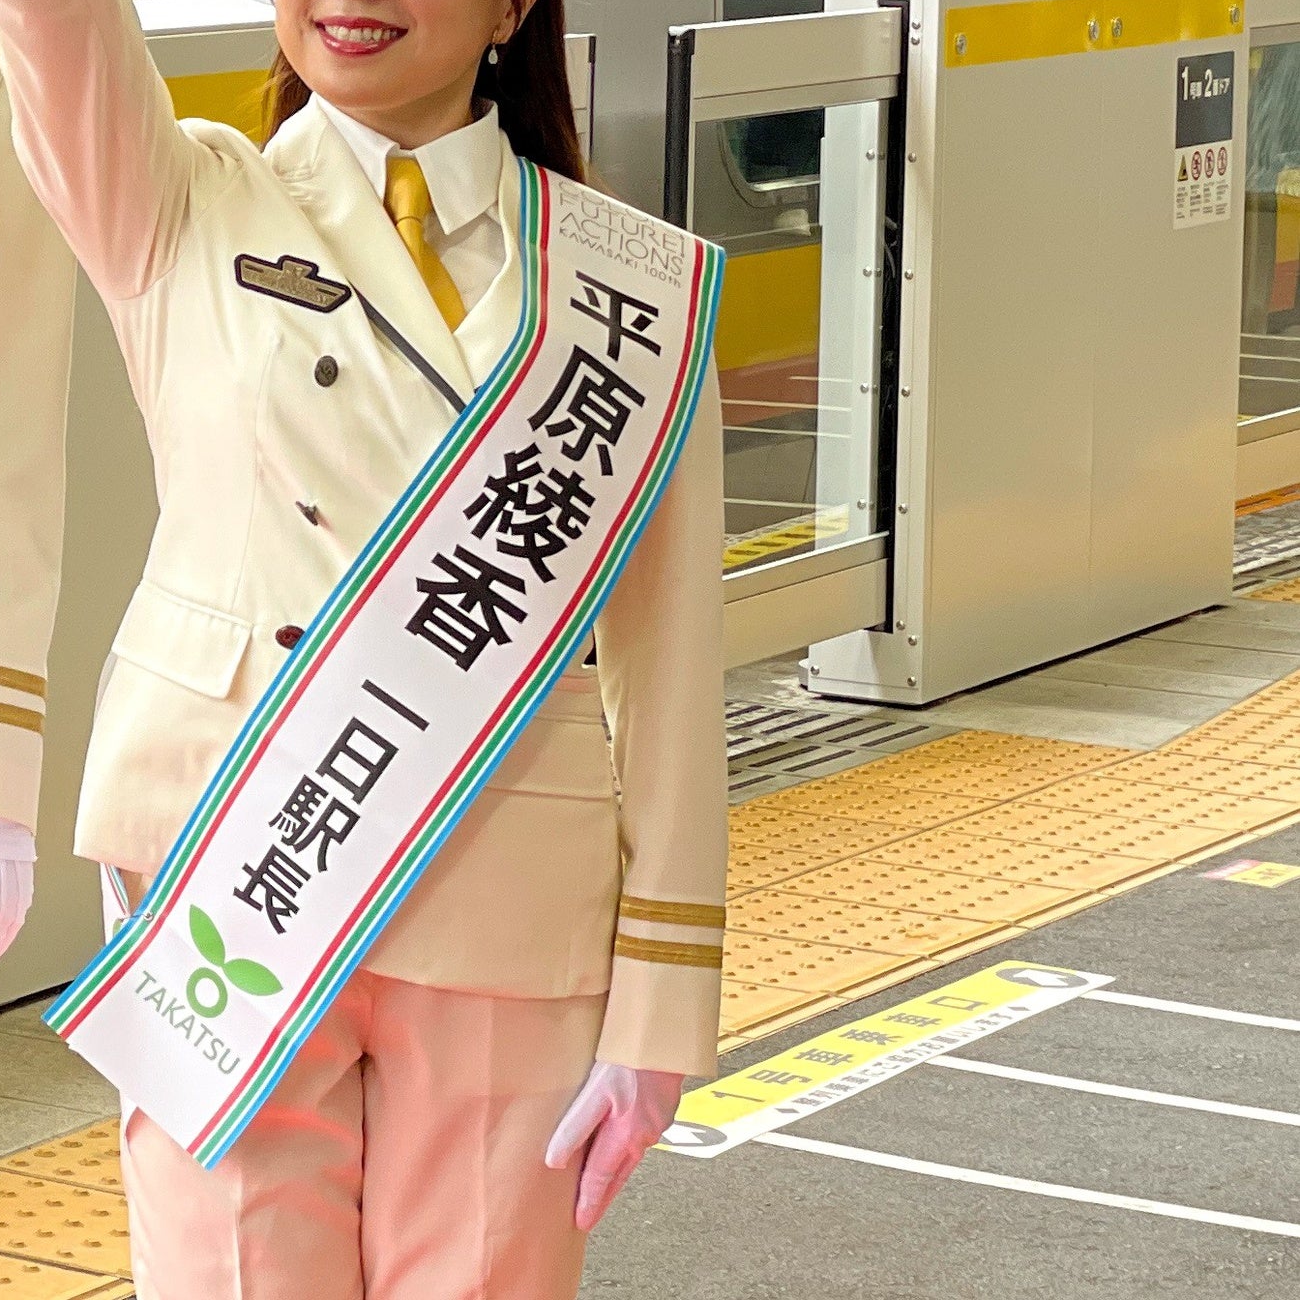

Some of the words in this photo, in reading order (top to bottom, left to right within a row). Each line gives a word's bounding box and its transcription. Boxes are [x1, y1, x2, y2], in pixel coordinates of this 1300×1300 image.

[558, 226, 638, 270] KAWASAKI
[644, 264, 681, 289] 100th
[560, 212, 684, 276] ACTIONS
[405, 270, 663, 673] 平原綾香
[232, 678, 430, 935] 一日駅長
[133, 970, 241, 1076] TAKATSU
